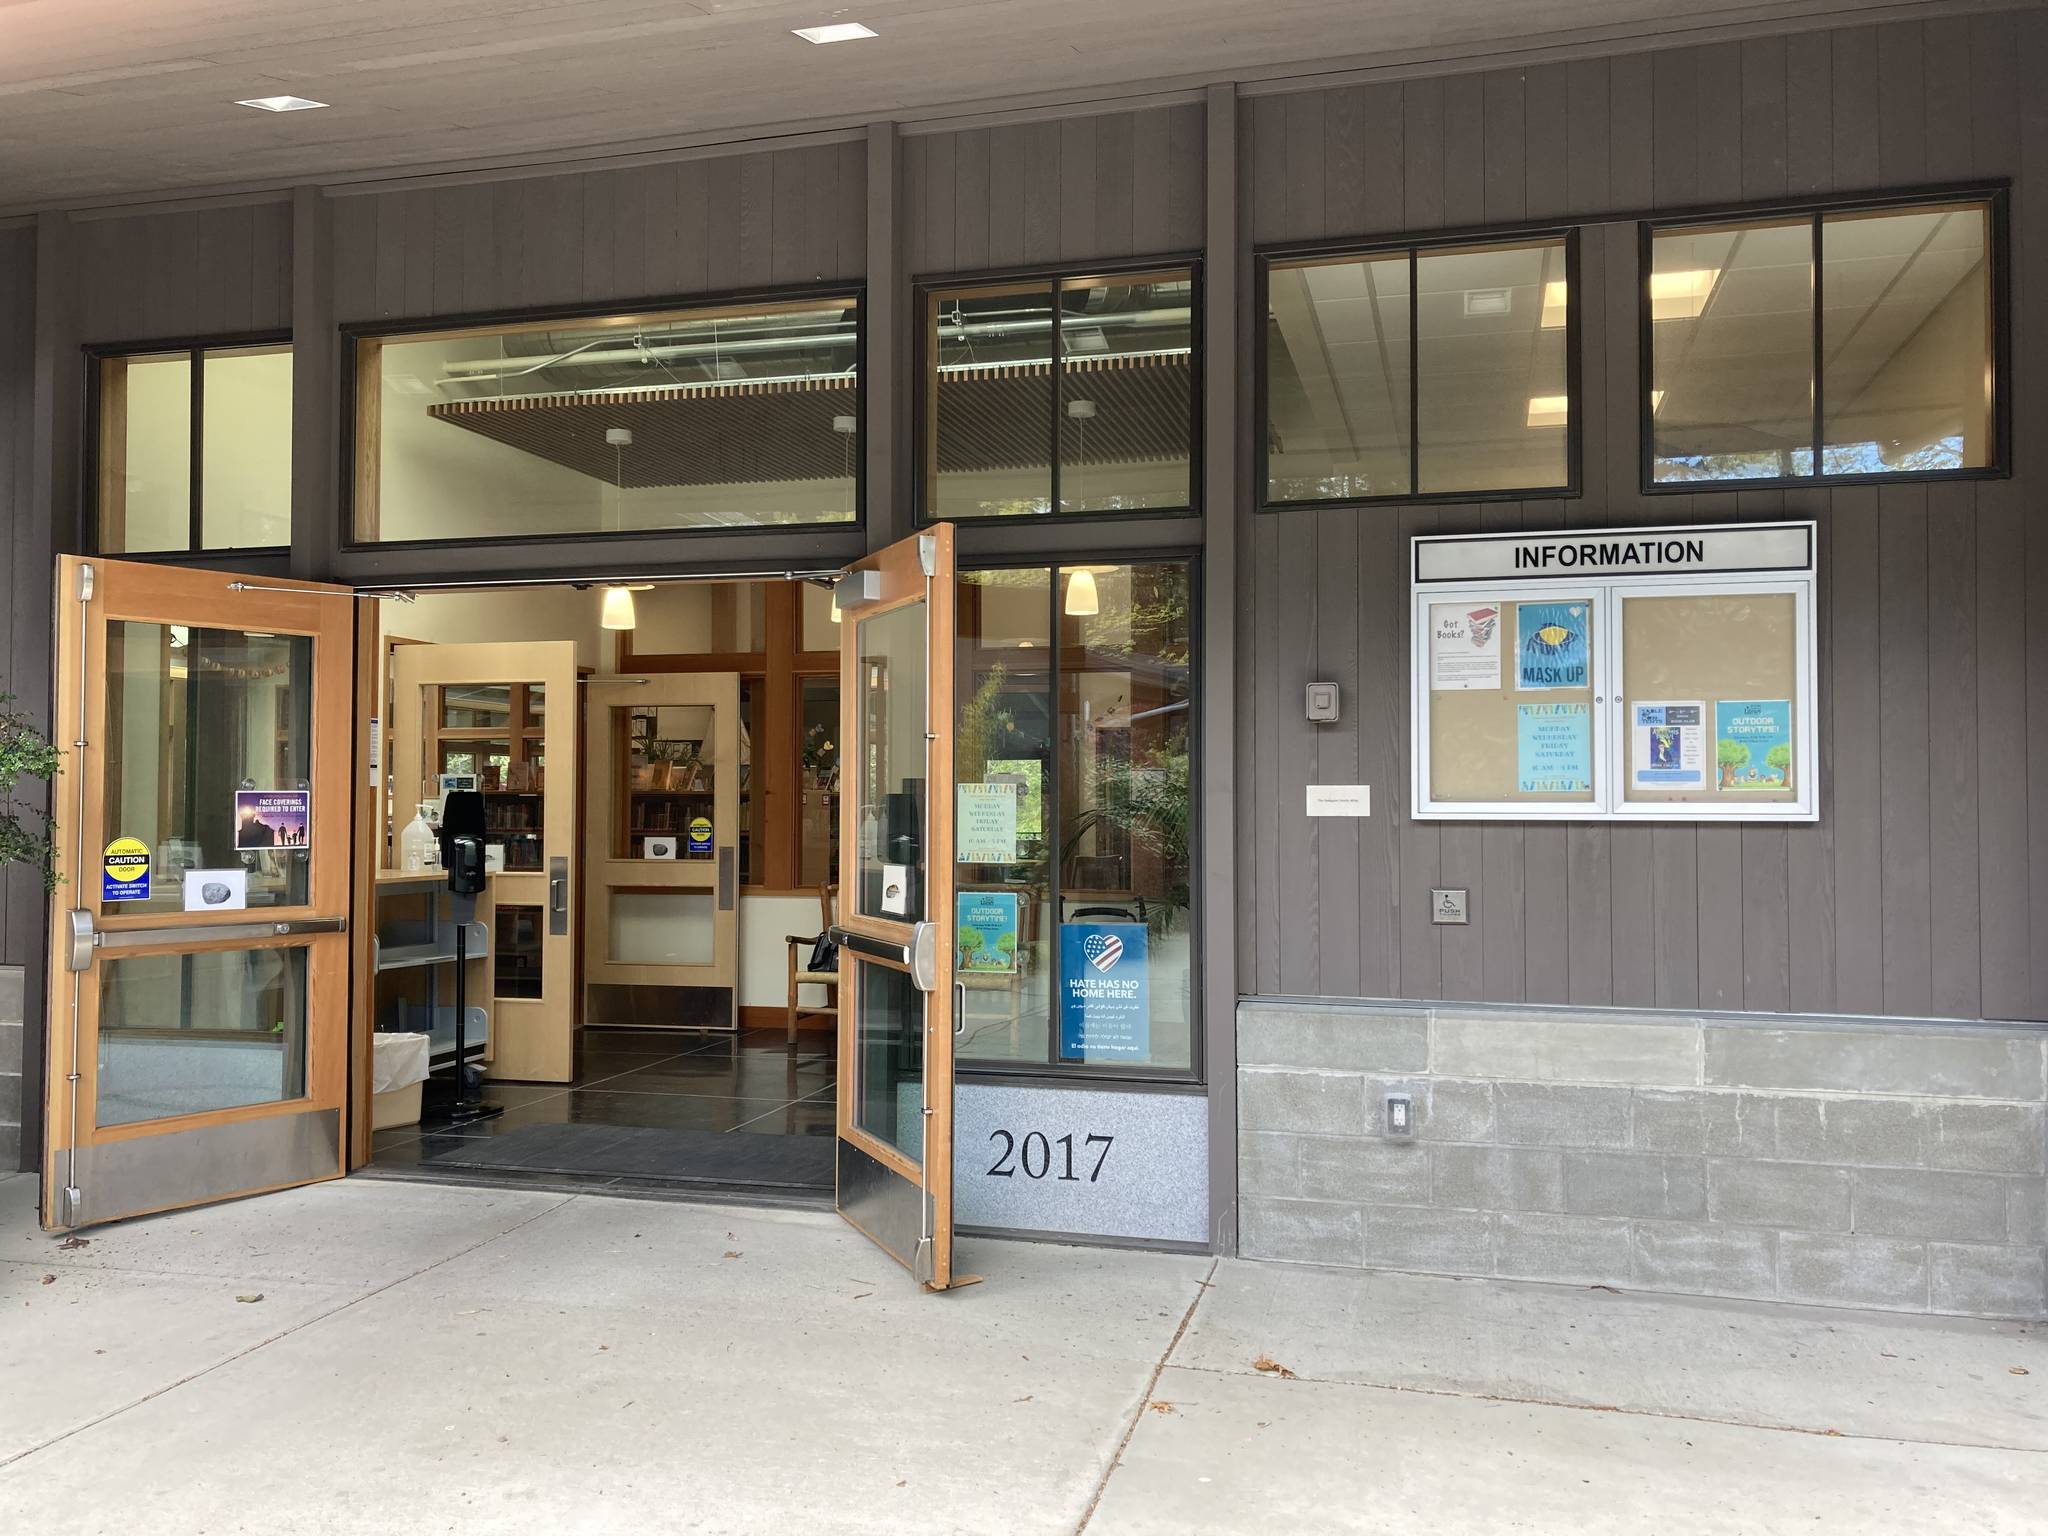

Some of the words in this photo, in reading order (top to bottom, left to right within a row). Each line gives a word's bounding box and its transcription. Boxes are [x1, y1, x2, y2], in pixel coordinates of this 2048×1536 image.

[1515, 540, 1704, 568] INFORMATION
[1443, 620, 1458, 629] Got
[1437, 630, 1465, 639] Books?
[1523, 667, 1562, 683] MASK
[1566, 666, 1584, 682] UP
[1732, 717, 1774, 725] OUTDOOR
[273, 798, 302, 806] COVERINGS
[108, 856, 146, 864] CAUTION
[970, 907, 1004, 915] OUTDOOR
[1069, 979, 1097, 988] HATE
[1098, 979, 1120, 989] HAS
[1122, 980, 1140, 990] NO
[1072, 989, 1105, 998] HOME
[1106, 989, 1137, 999] HERE.
[986, 1129, 1115, 1183] 2017
